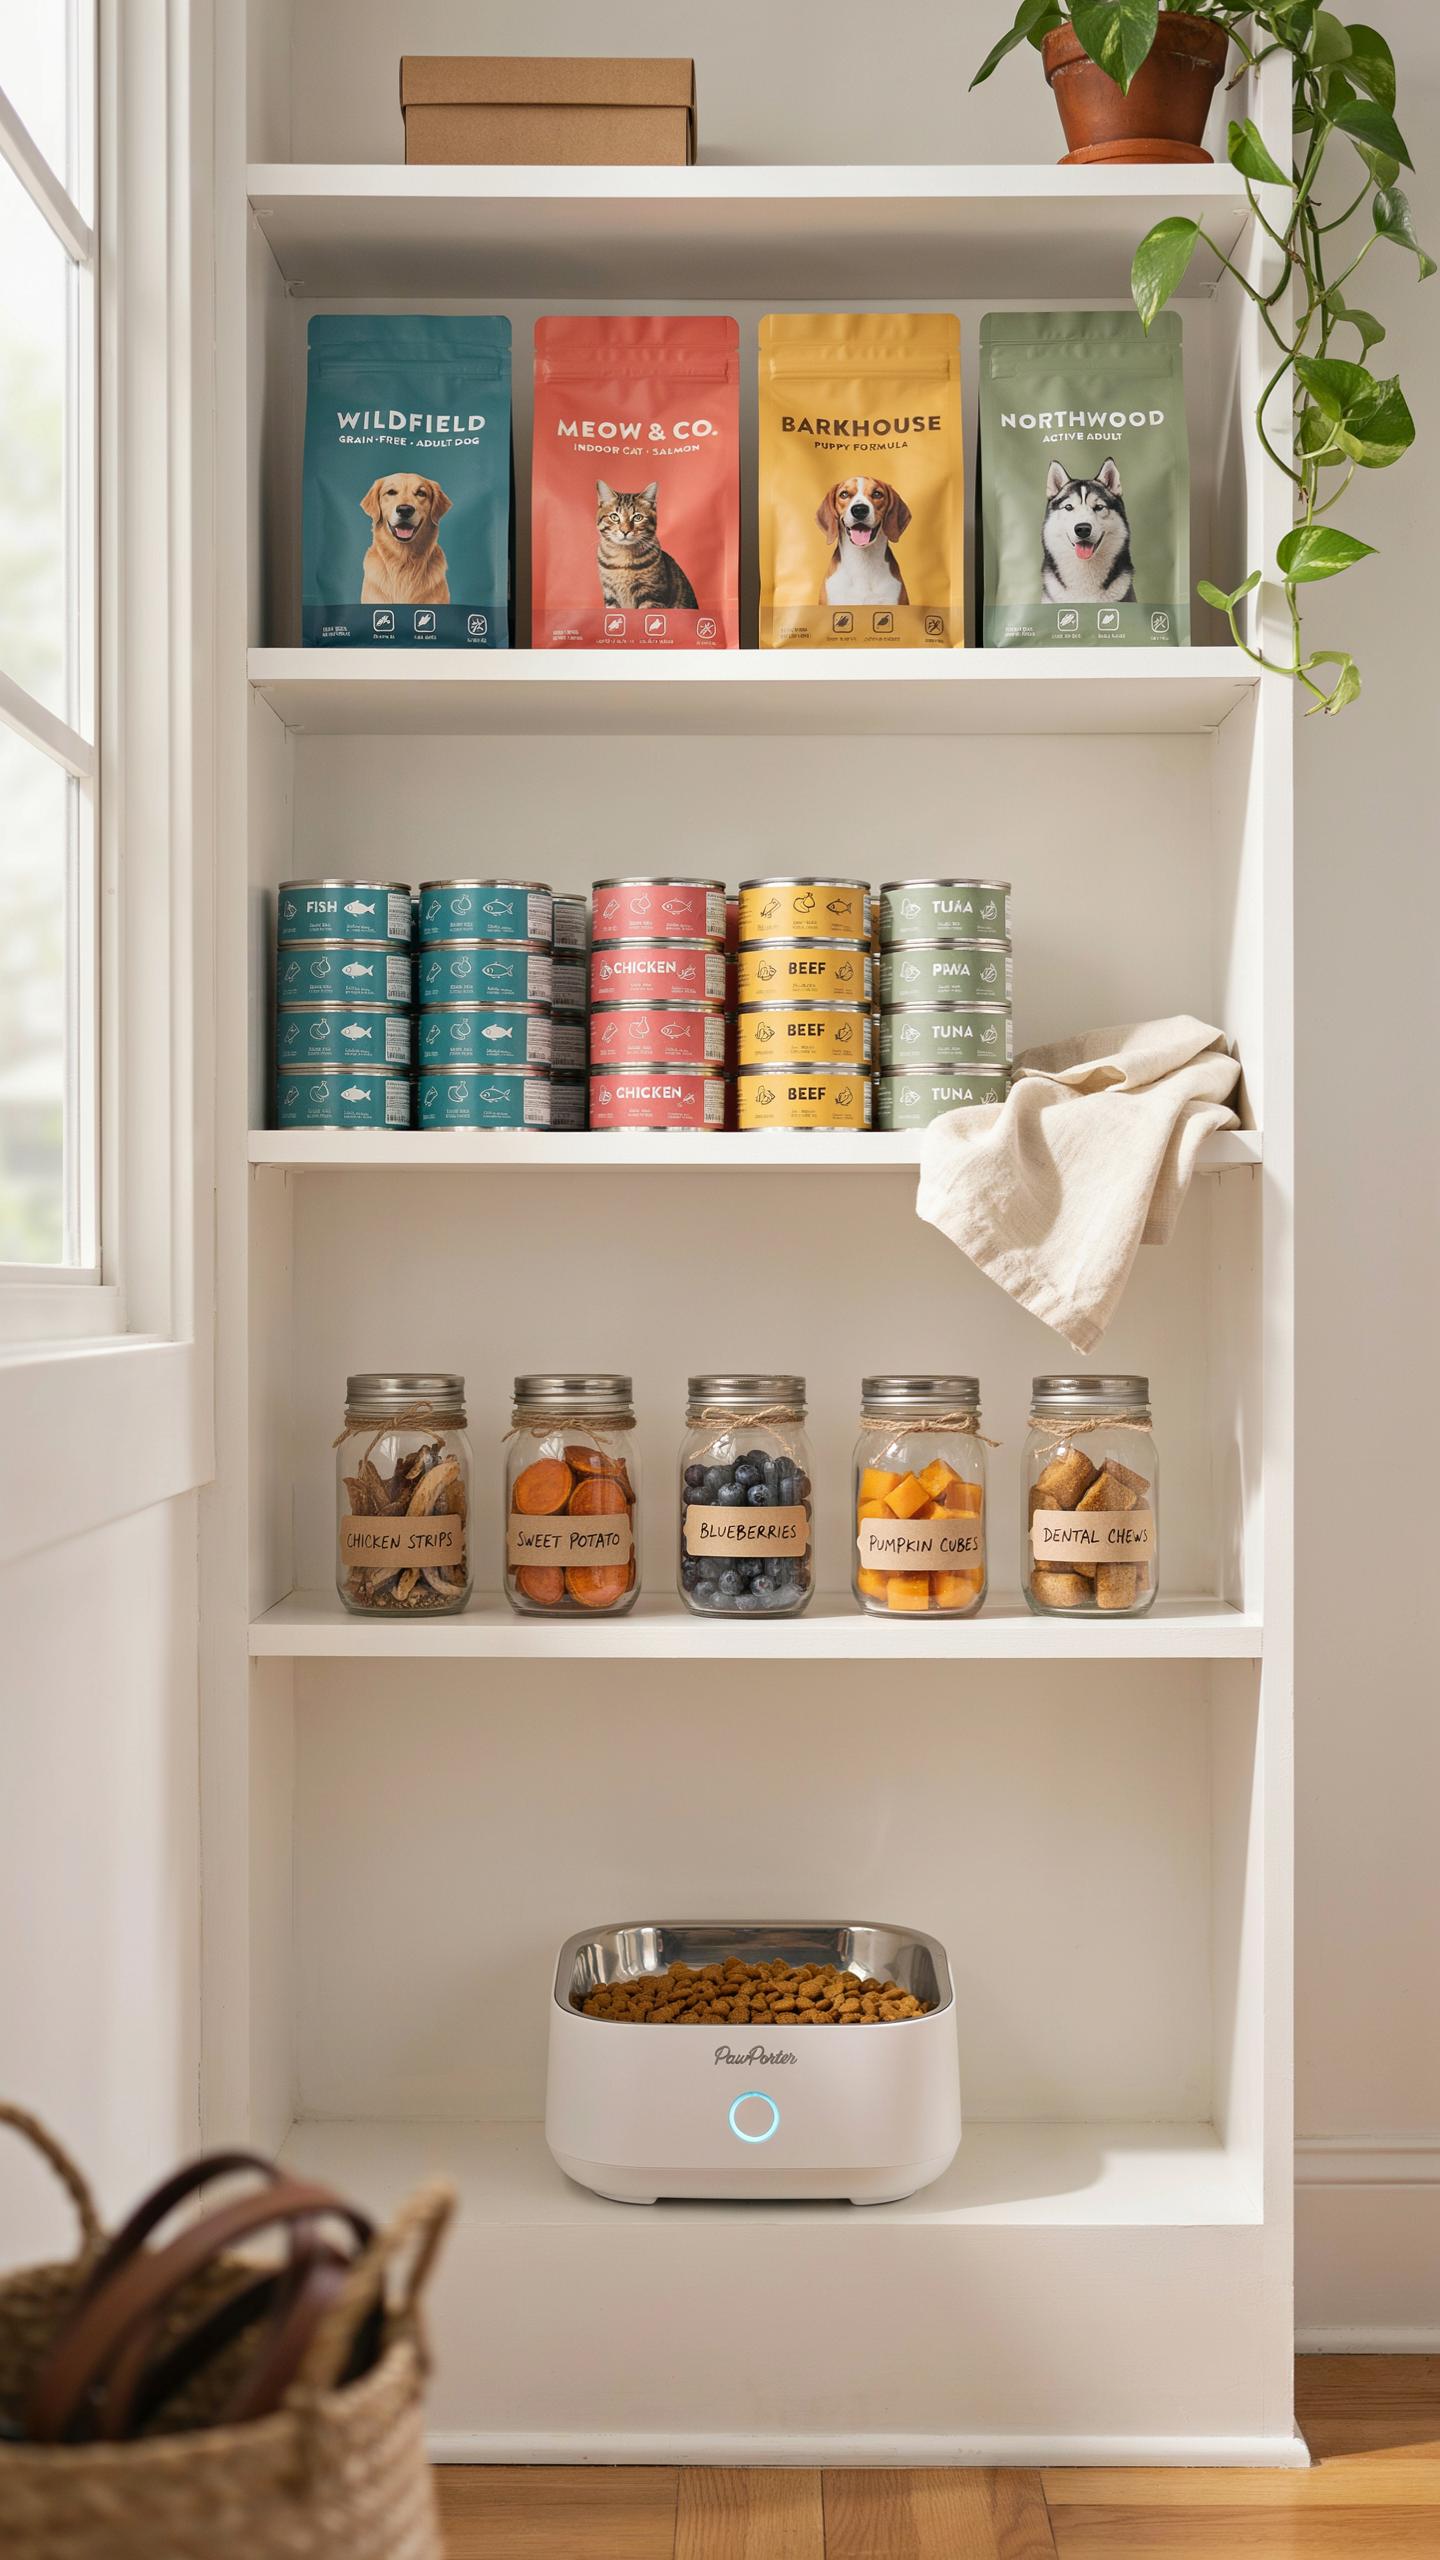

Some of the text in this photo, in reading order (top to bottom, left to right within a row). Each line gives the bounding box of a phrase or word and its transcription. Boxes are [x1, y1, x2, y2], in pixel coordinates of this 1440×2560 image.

[337, 410, 486, 433] WILDFIELD
[1001, 410, 1164, 429] NORTHWOOD
[557, 419, 719, 441] MEOW & CO.
[782, 416, 941, 437] BARKHOUSE
[416, 439, 452, 448] ADULT
[454, 437, 480, 446] DOG
[1042, 432, 1122, 443] ACTIVE ADULT
[574, 443, 700, 456] INDOOR CAT SALMON
[814, 441, 908, 451] PUPPY FORMULA
[306, 901, 338, 913] FISH
[613, 961, 677, 974] CHICKEN
[788, 962, 826, 975] BEEF
[787, 1024, 825, 1037] BEEF
[931, 1025, 973, 1038] TUNA
[616, 1086, 682, 1099] CHICKEN
[788, 1087, 826, 1100] BEEF
[931, 1087, 973, 1101] TUNA
[699, 1522, 797, 1541] BLUEBERRIES
[1043, 1527, 1148, 1544] DENTAL CHEWS
[346, 1531, 453, 1549] CHICKEN STRIPS
[516, 1531, 620, 1549] SWEET POTATO
[869, 1534, 979, 1554] PUMPKIN CUBES
[714, 2045, 798, 2066] PawPorter
